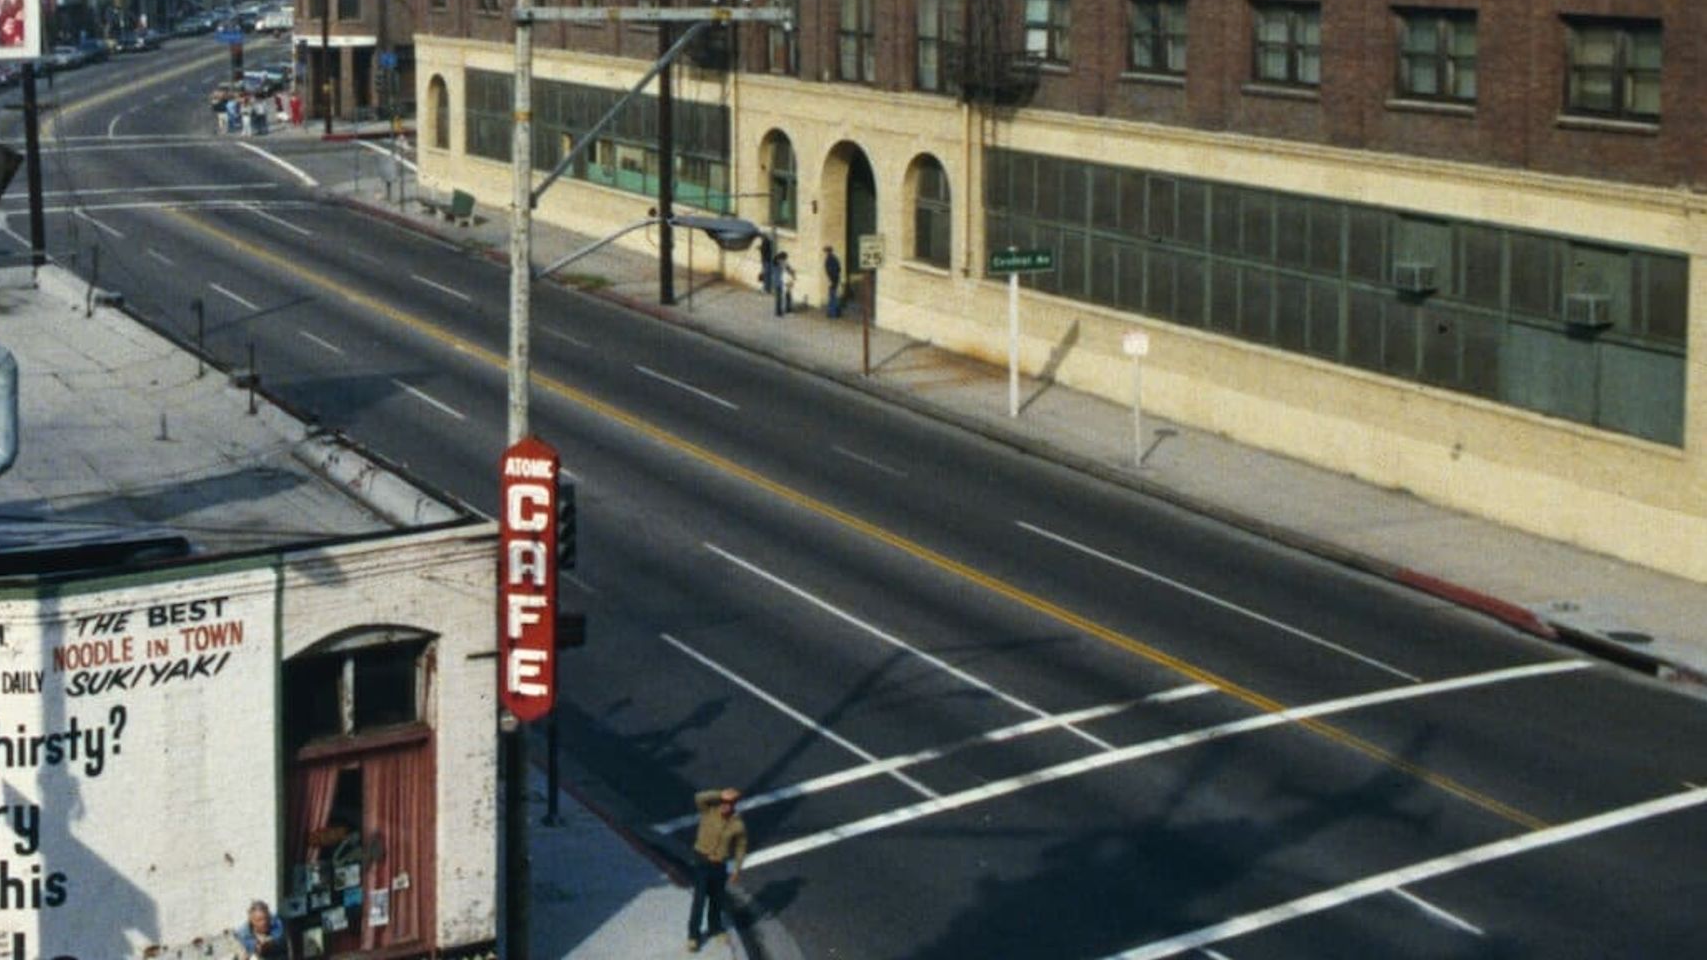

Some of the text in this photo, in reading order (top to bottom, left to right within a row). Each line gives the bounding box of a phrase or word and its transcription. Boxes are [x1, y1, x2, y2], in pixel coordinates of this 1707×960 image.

[507, 483, 550, 696] CAFE
[74, 596, 229, 637] THE BEST
[53, 621, 244, 672] NOODLE IN TOWN
[2, 671, 45, 695] DAILY
[65, 651, 231, 697] SUKIYAKI
